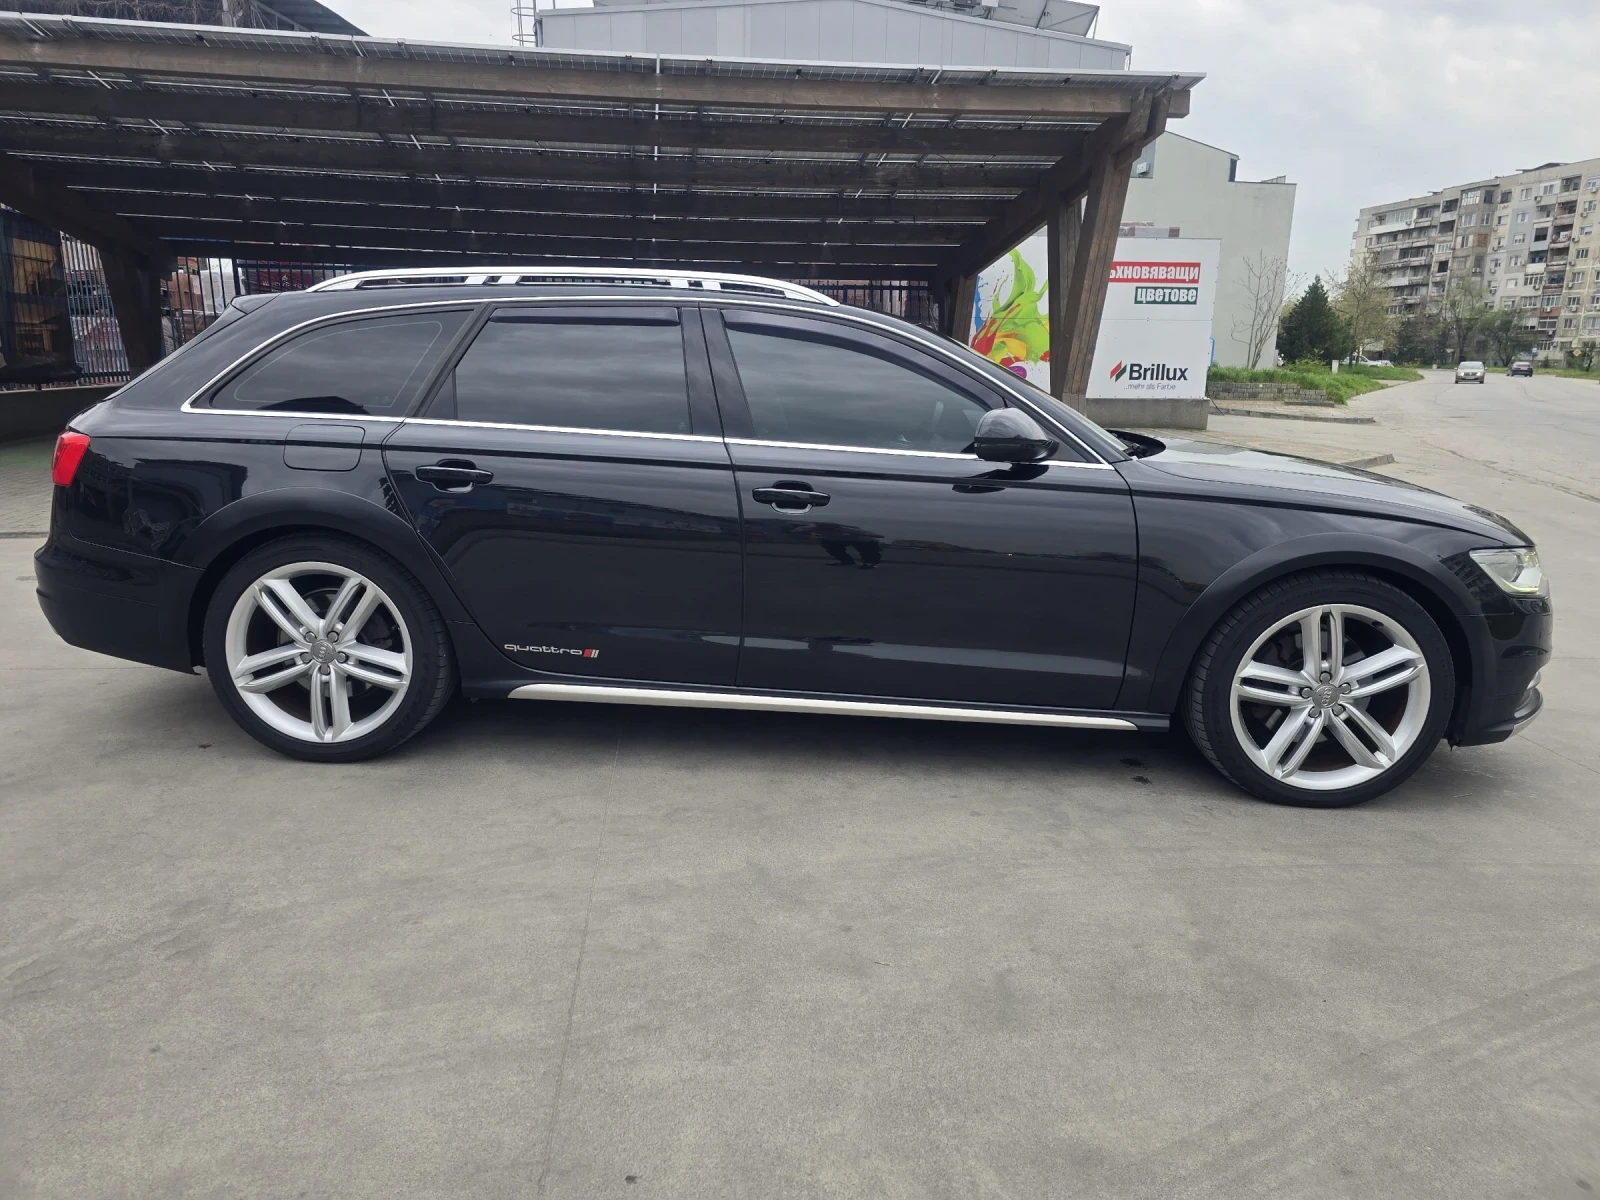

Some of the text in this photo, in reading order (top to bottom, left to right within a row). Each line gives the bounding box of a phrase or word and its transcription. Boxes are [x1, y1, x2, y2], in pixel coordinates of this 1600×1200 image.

[1137, 288, 1197, 303] цветове
[1128, 363, 1188, 381] Brillux
[1156, 382, 1176, 390] Farbe
[504, 644, 583, 655] quattro
